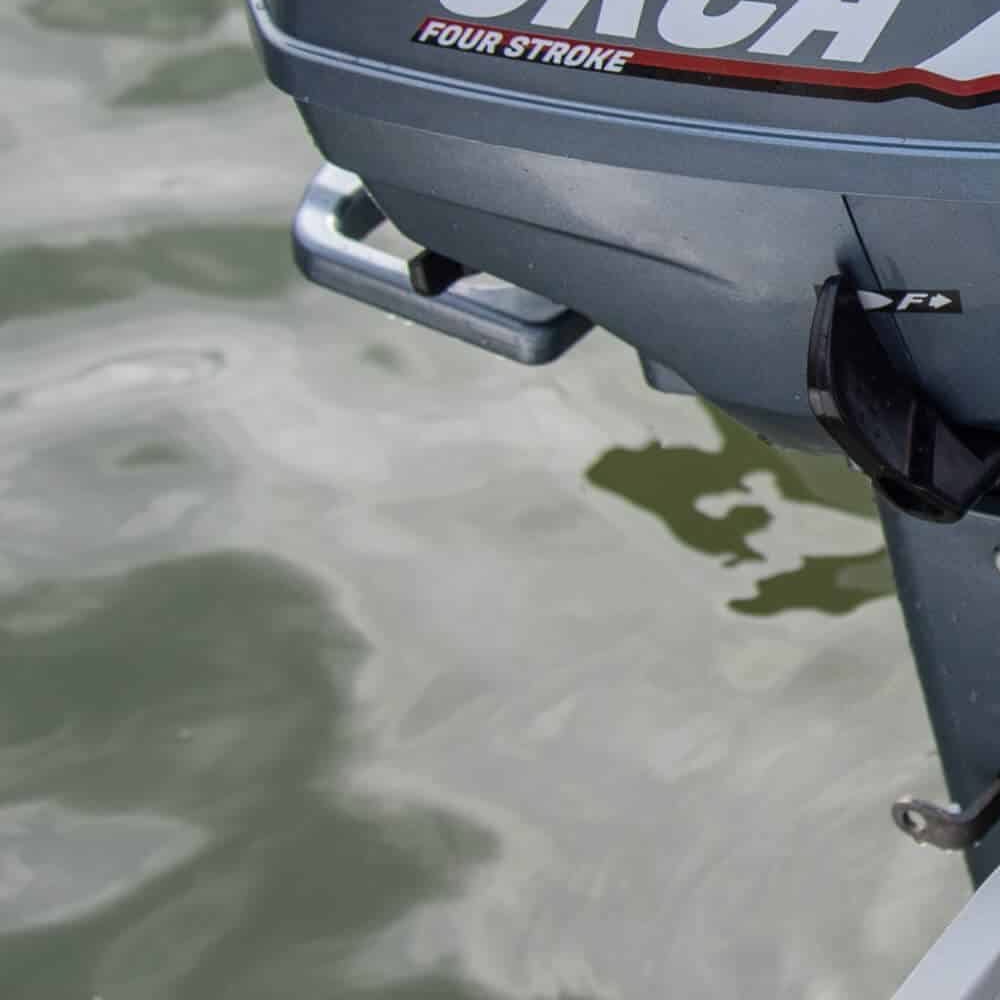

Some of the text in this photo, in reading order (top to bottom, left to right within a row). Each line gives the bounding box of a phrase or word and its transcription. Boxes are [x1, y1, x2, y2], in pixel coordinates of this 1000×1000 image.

[418, 20, 635, 73] FOUR STROKE
[896, 293, 929, 311] F
